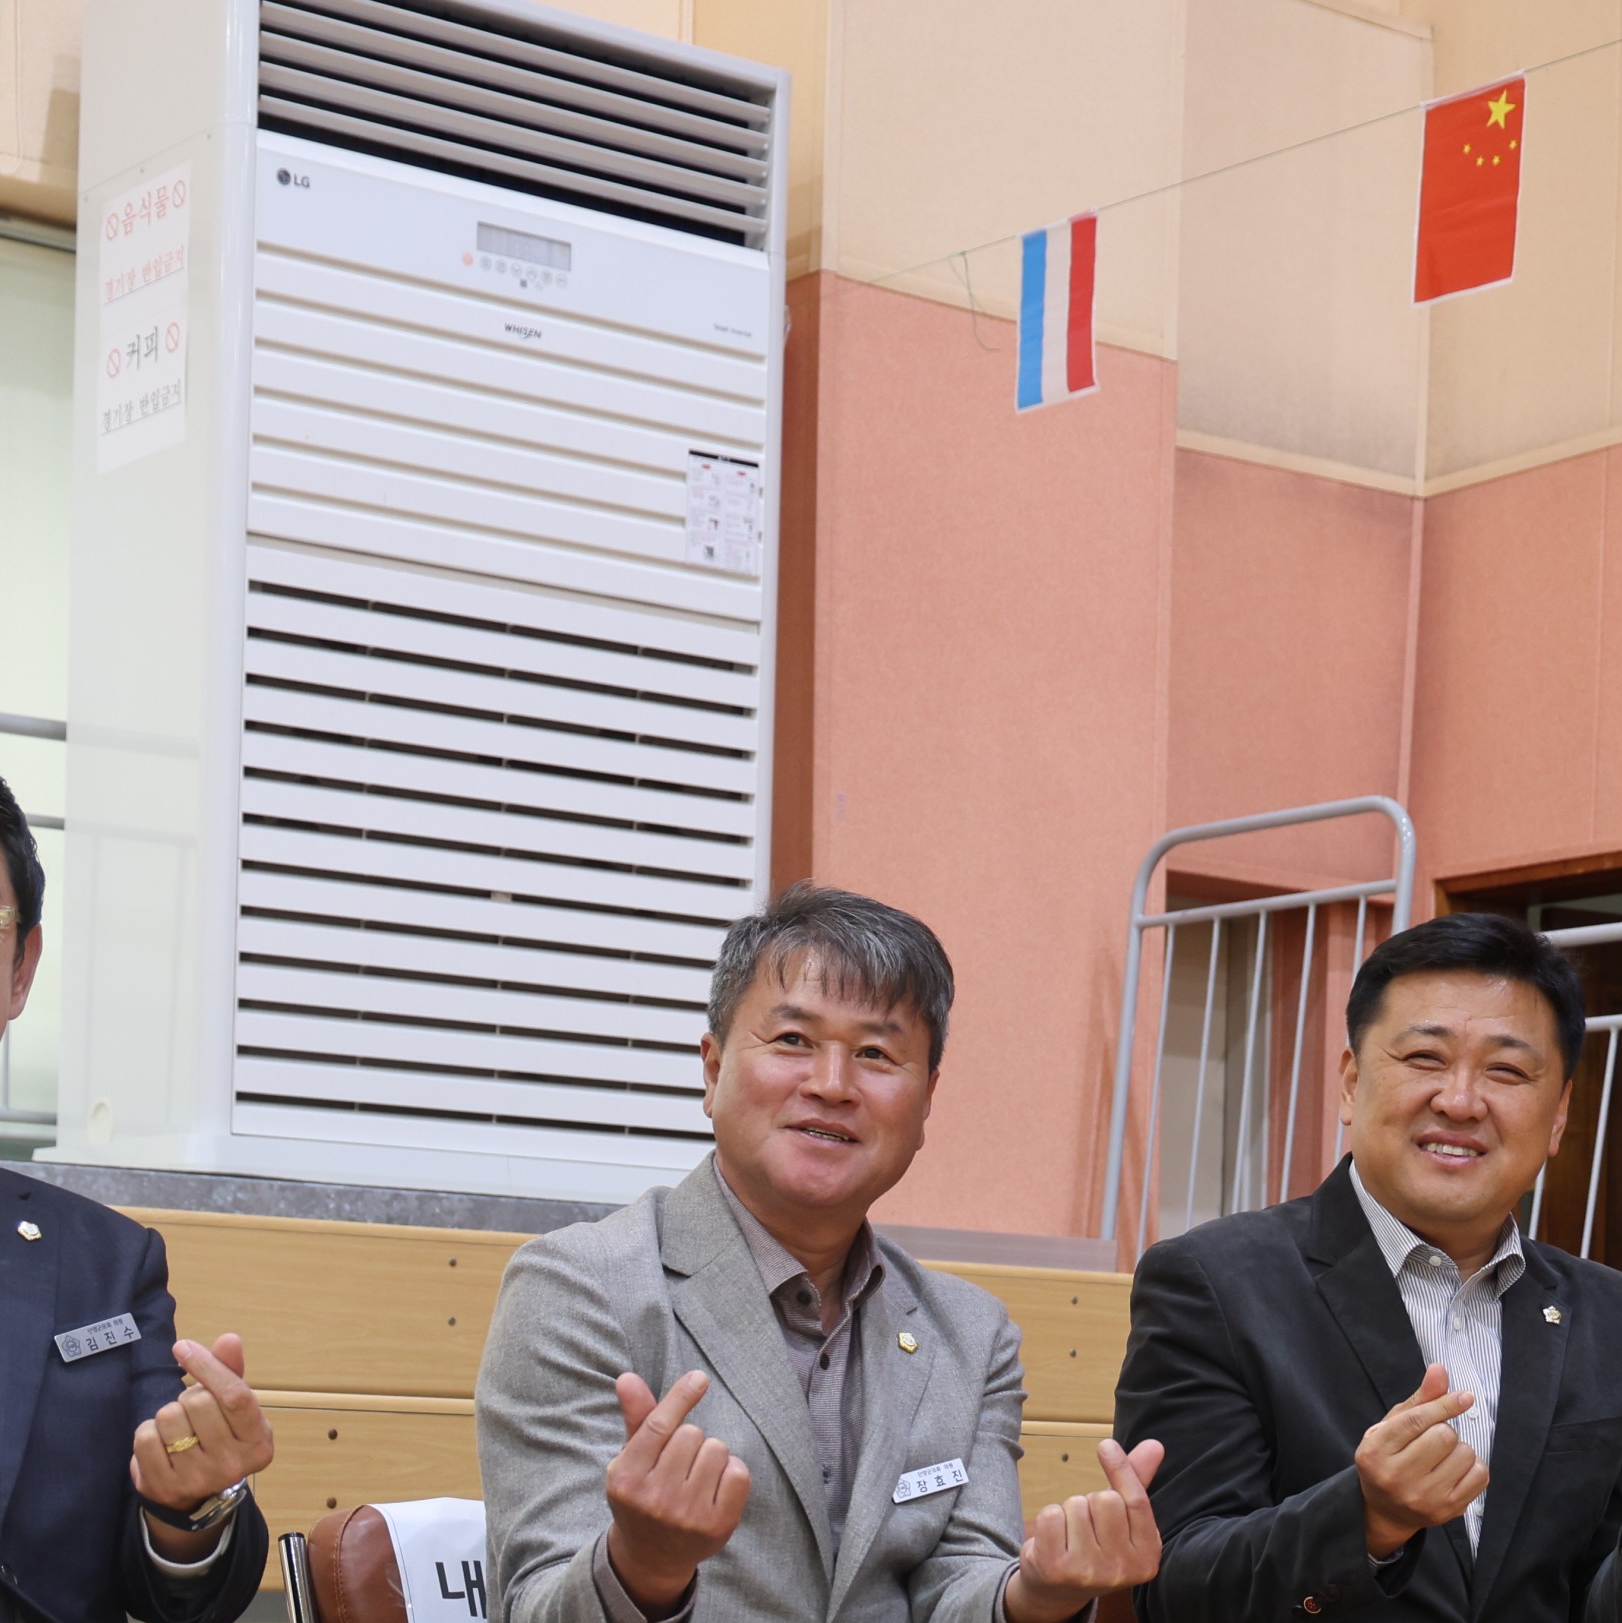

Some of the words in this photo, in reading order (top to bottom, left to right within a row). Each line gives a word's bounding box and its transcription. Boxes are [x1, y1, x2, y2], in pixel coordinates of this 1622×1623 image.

[293, 173, 310, 188] LG
[121, 185, 170, 236] 음식물
[104, 267, 137, 302] 경기장
[141, 244, 185, 284] 반입금지
[125, 325, 159, 371] 커피
[504, 322, 542, 340] WHISEN
[102, 399, 134, 431] 경기장
[138, 378, 182, 417] 반입금지
